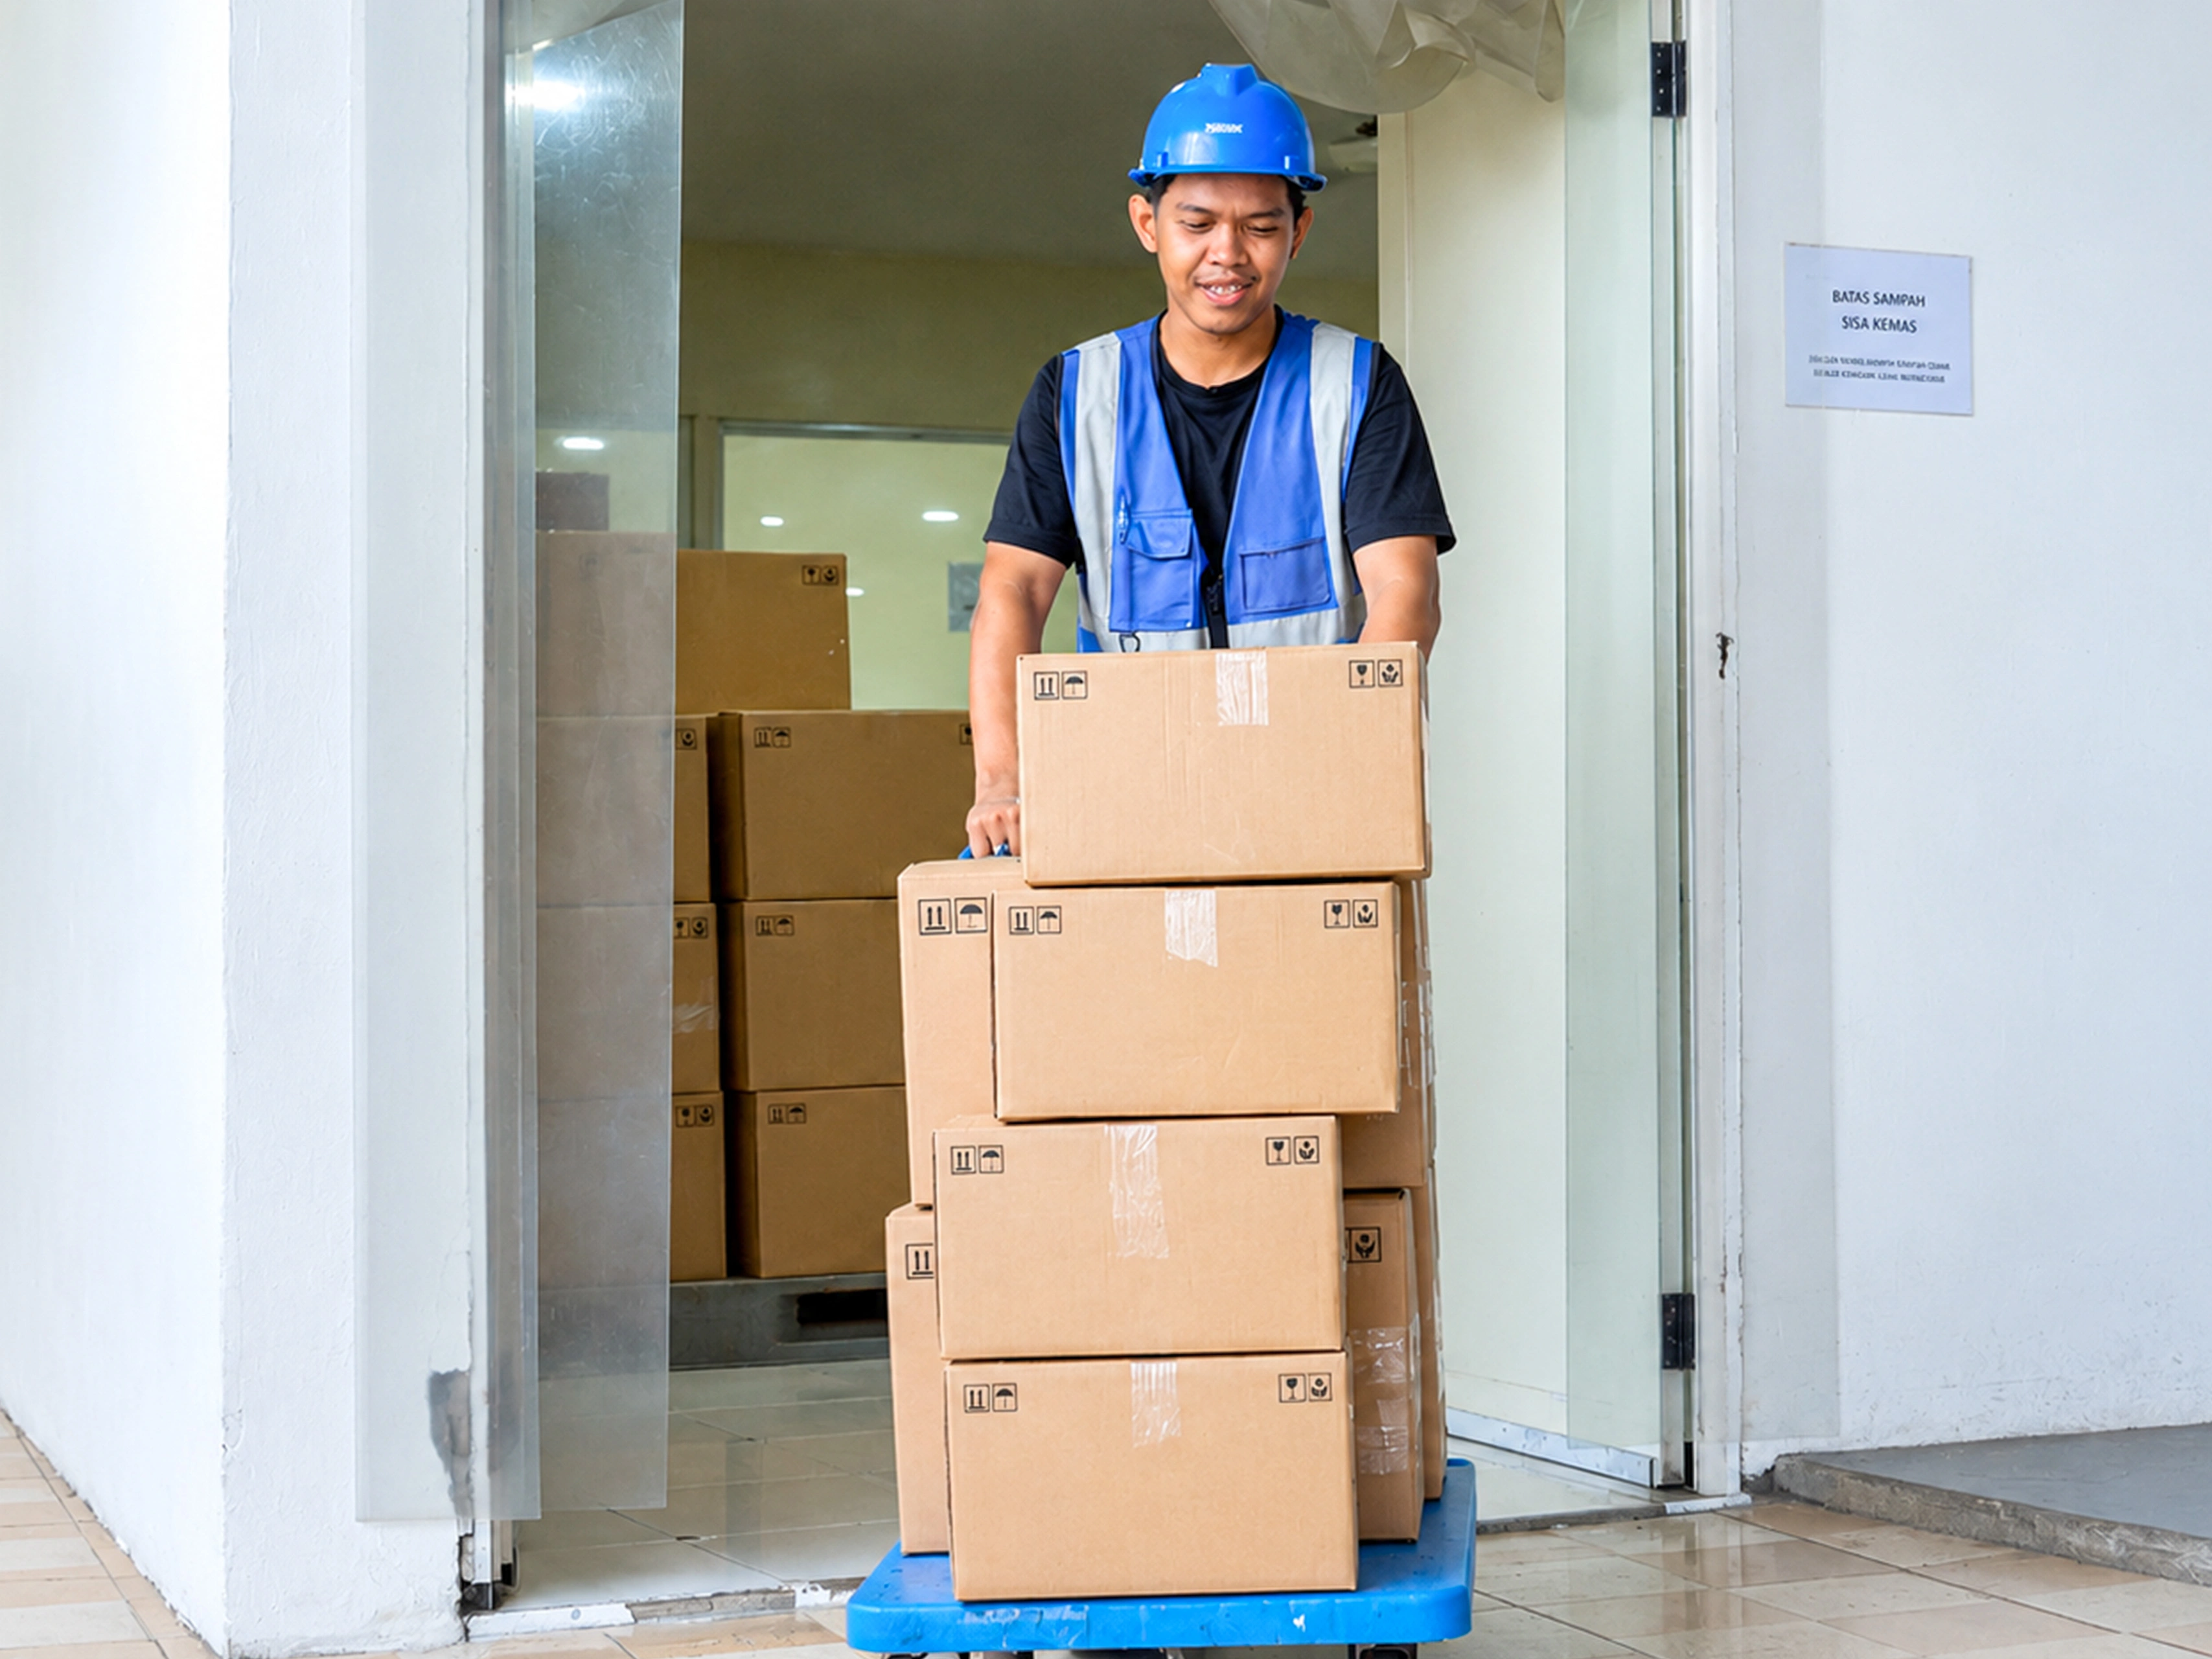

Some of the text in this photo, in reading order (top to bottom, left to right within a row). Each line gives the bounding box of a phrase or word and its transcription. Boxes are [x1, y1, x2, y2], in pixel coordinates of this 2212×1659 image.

[1832, 290, 1926, 307] BATAS SAMPAH
[1841, 315, 1917, 334] SISA KEMAS
